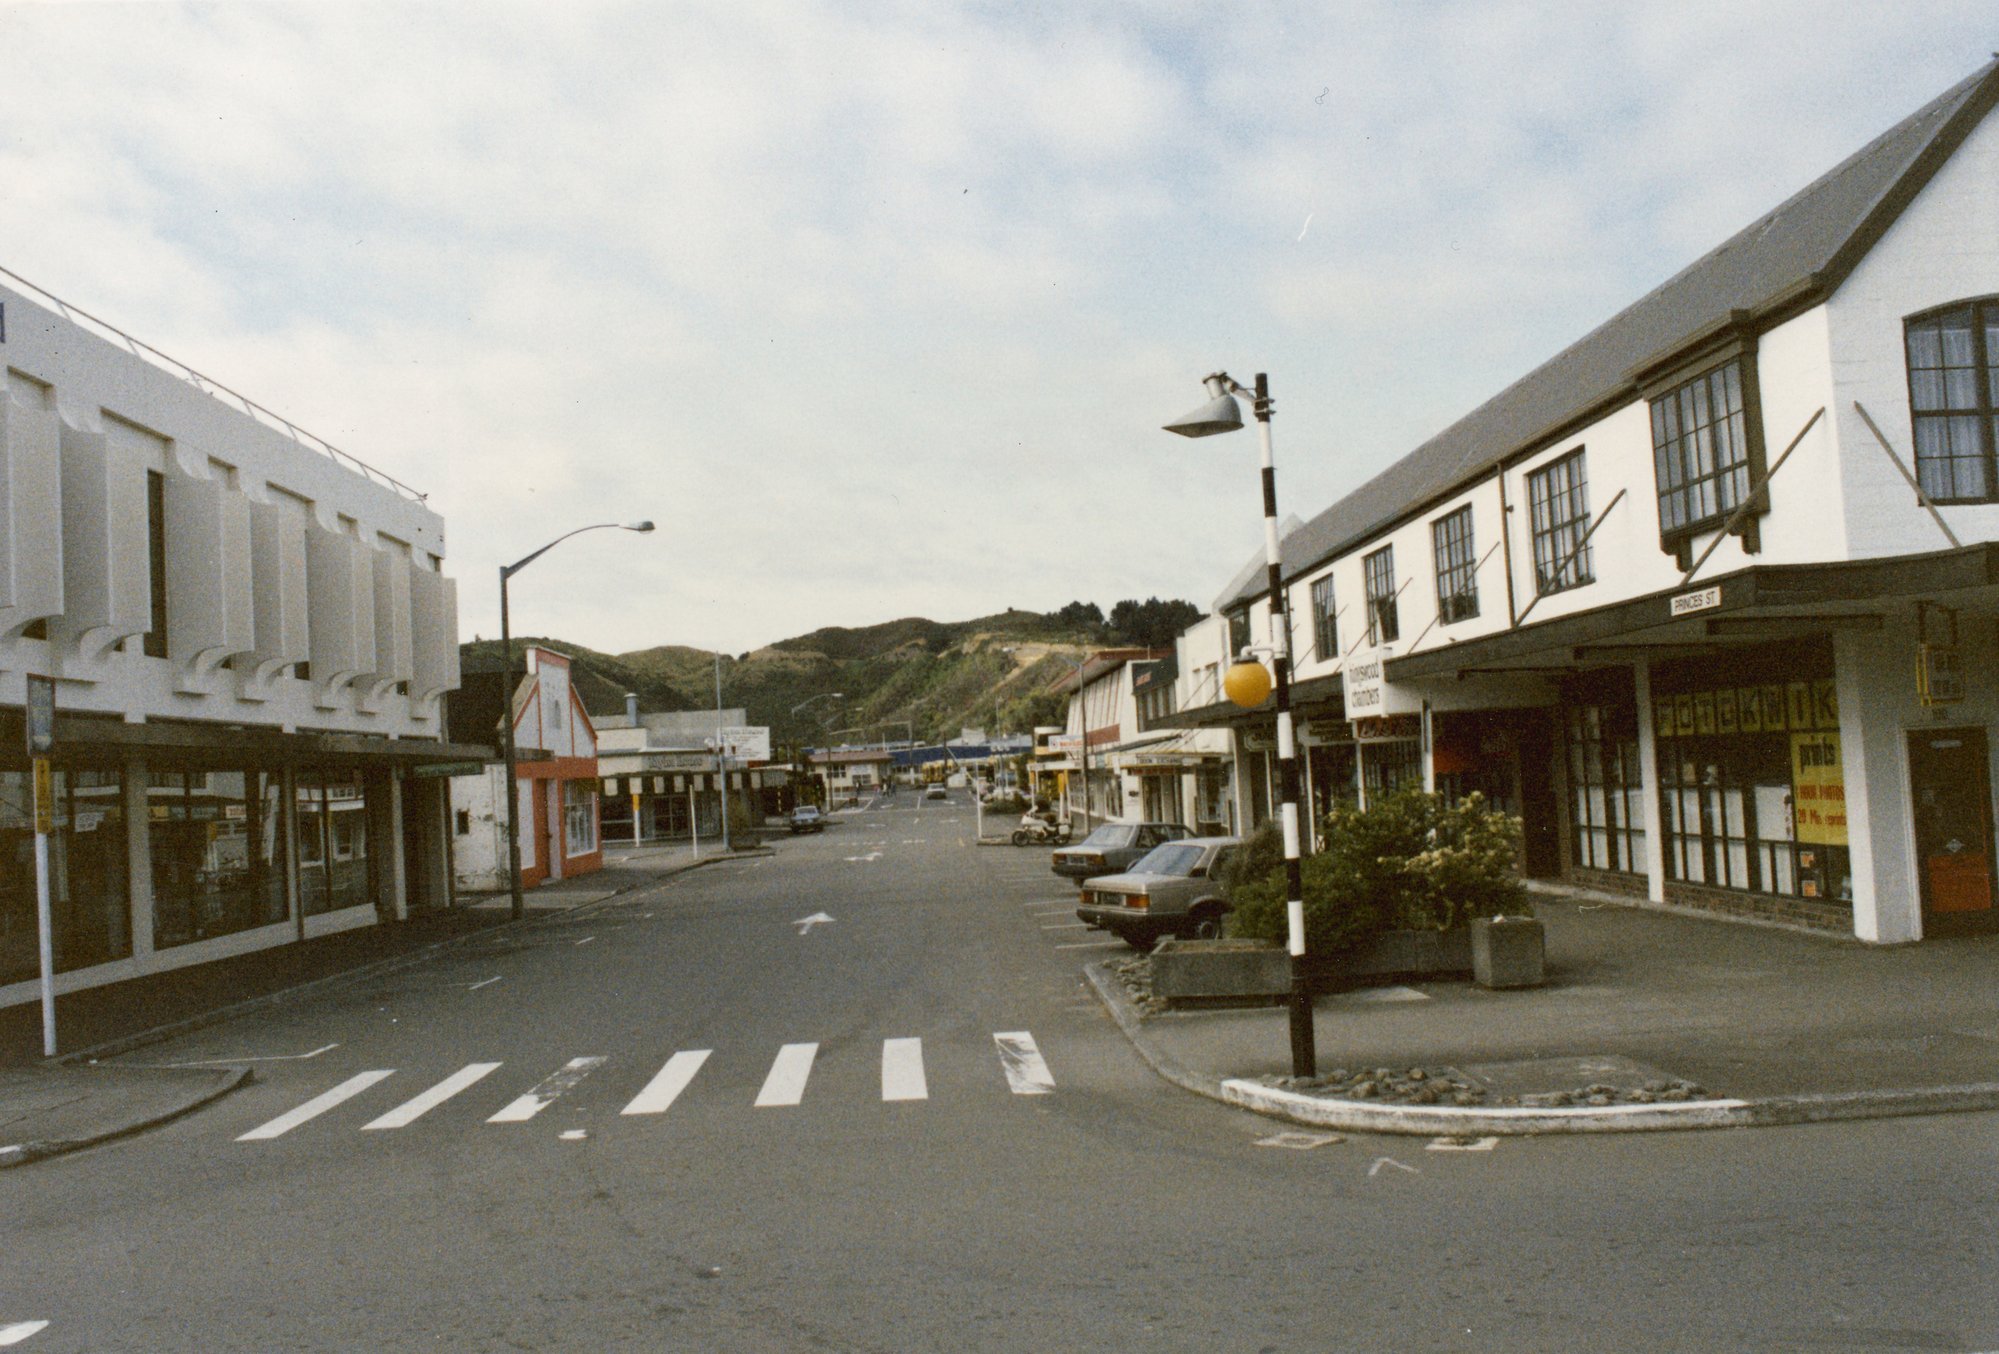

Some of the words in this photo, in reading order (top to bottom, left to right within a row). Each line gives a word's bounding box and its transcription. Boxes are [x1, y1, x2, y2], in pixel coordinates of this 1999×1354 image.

[1674, 594, 1703, 611] PRINCES
[1705, 590, 1716, 607] ST
[1799, 735, 1835, 775] prints
